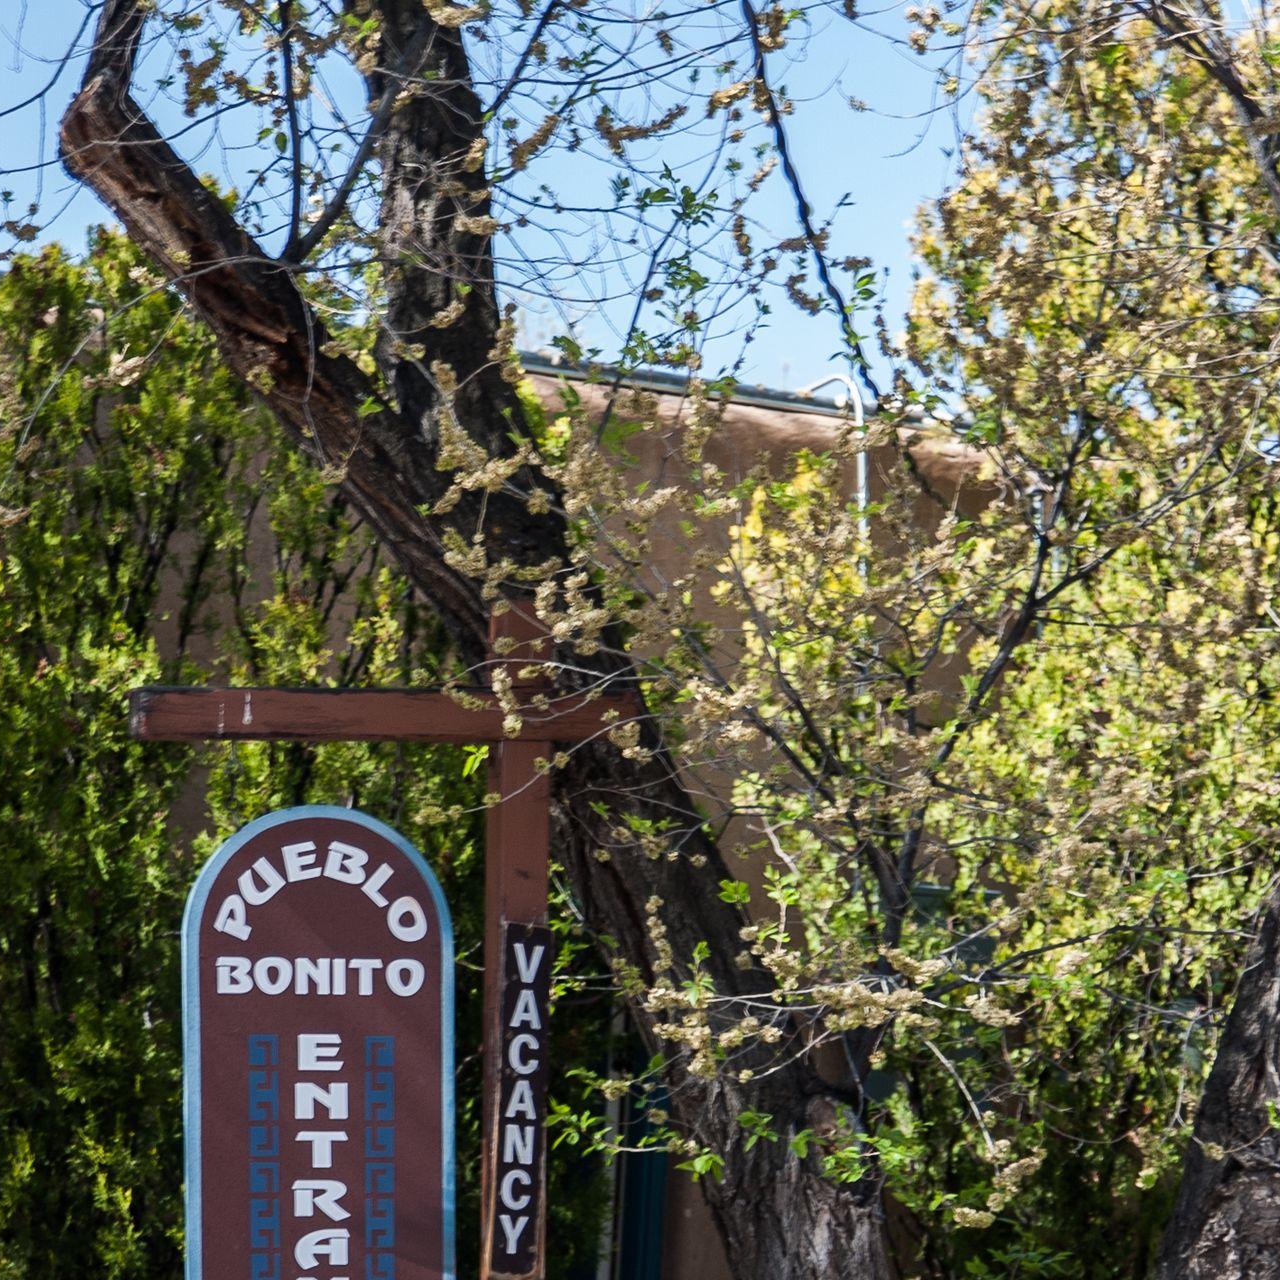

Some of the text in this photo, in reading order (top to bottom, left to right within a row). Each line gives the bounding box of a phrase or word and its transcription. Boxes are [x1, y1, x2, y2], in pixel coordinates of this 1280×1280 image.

[214, 841, 427, 942] PUEBLO
[214, 956, 425, 997] BONITO
[498, 942, 544, 1255] VACANCY
